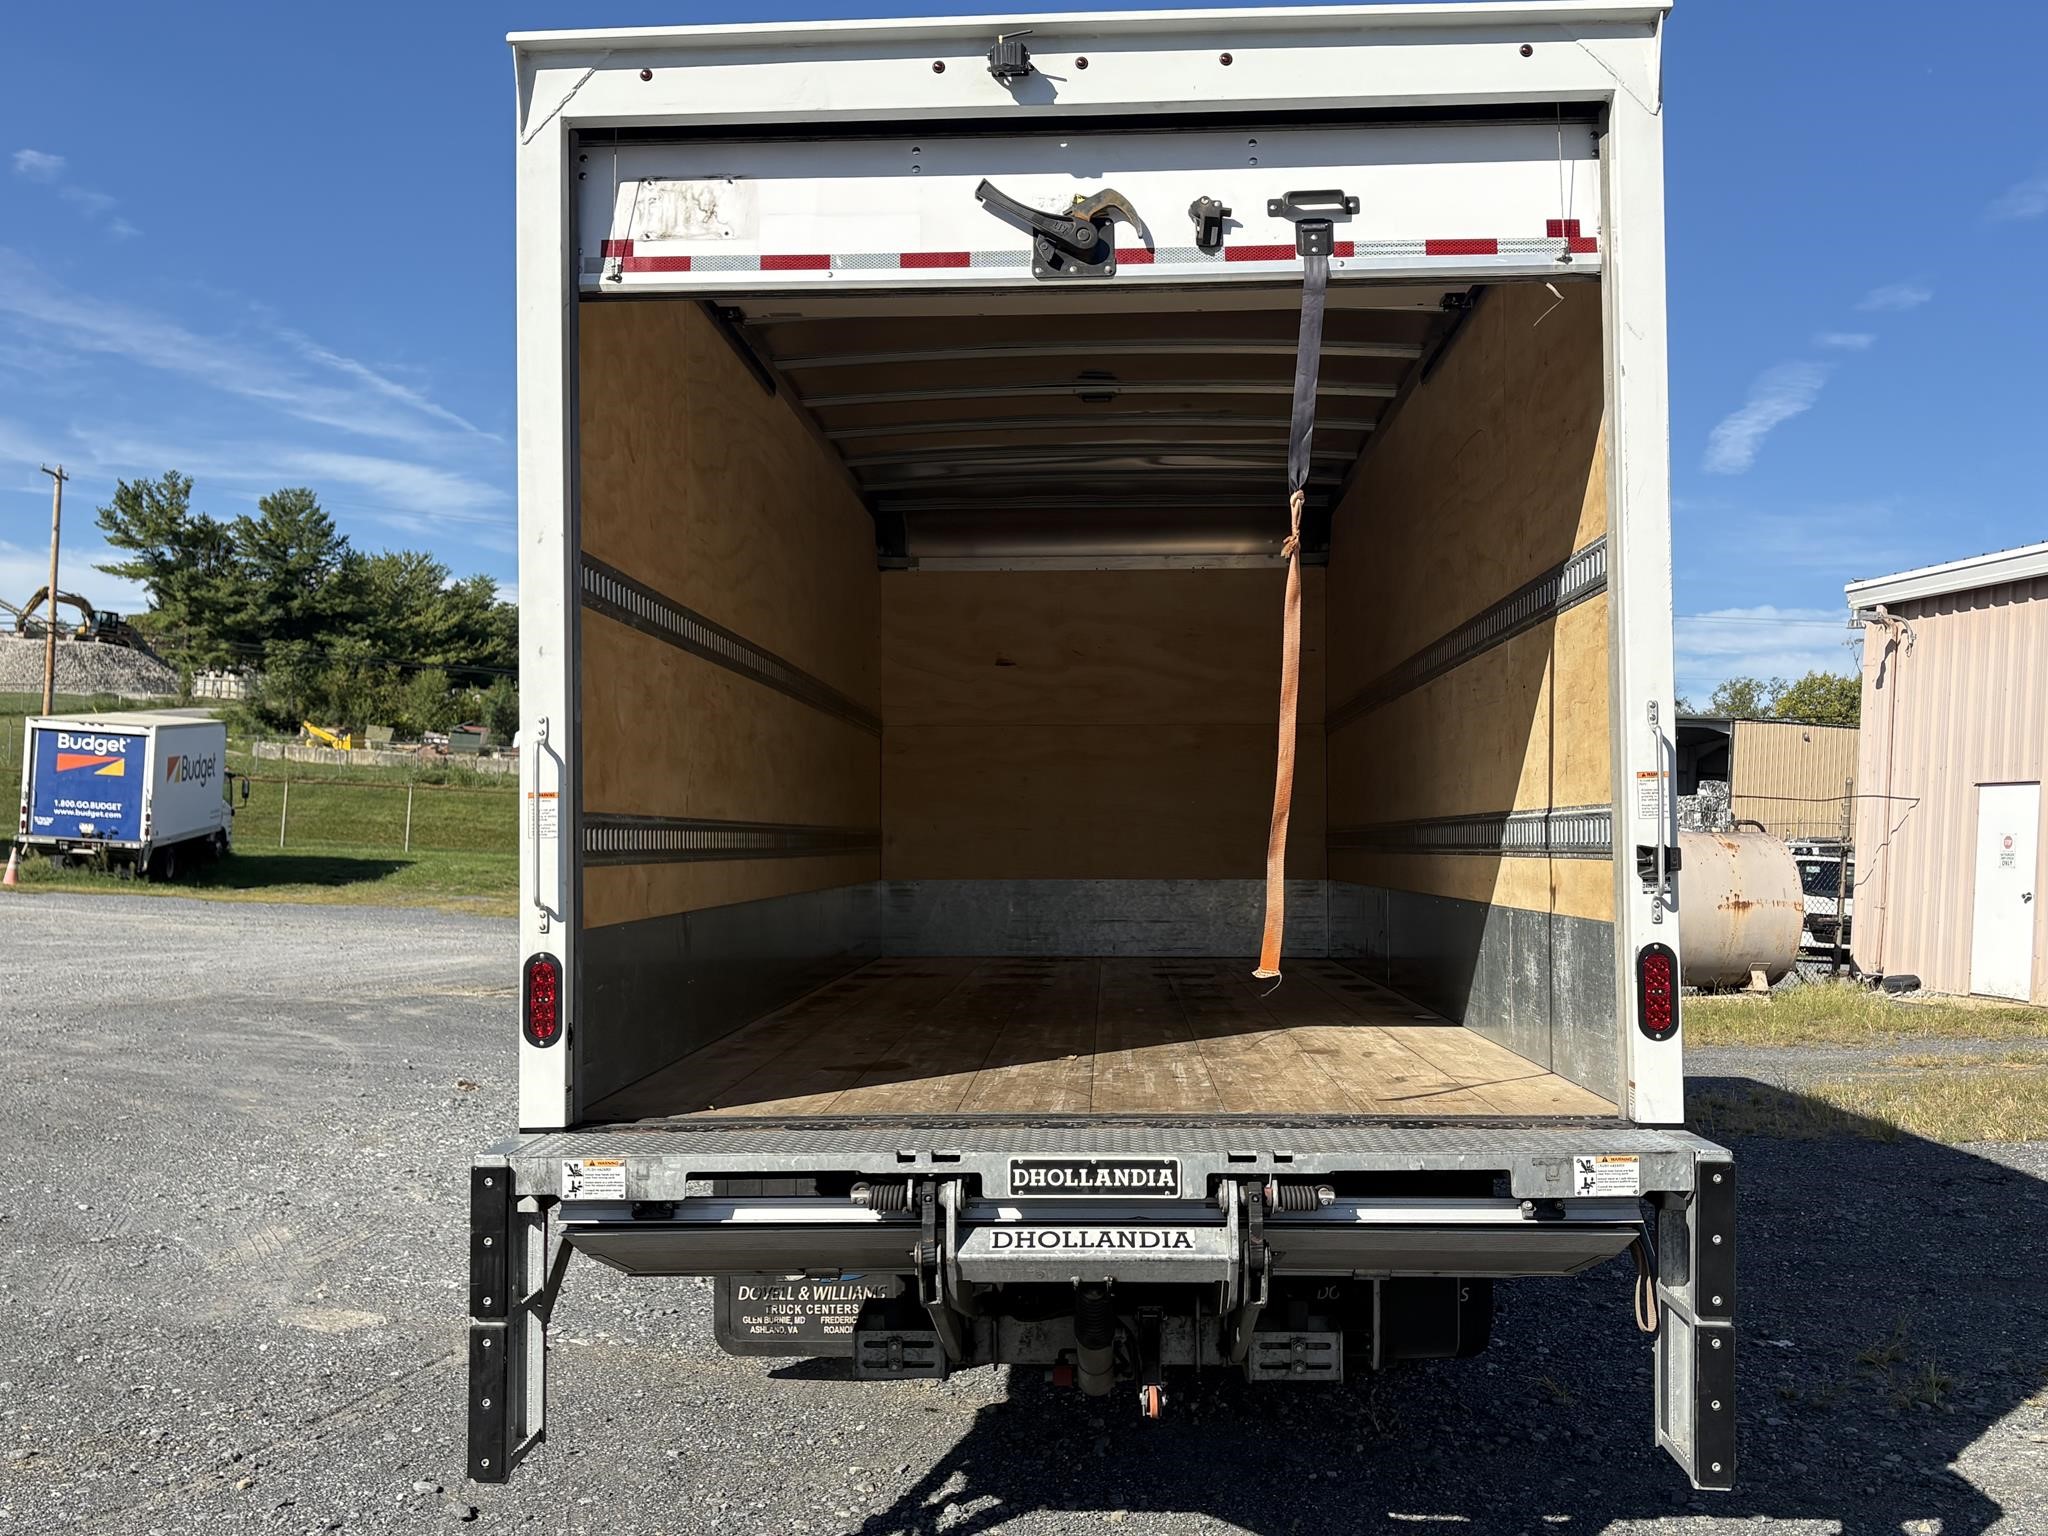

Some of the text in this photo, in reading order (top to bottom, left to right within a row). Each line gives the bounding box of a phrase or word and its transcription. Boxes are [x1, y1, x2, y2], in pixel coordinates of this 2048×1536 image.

[57, 732, 127, 756] Budget
[181, 752, 216, 788] Budget
[53, 808, 122, 819] www.budget.com
[1012, 1168, 1176, 1187] DHOLLANDIA
[991, 1230, 1193, 1249] DHOLLANDIA
[738, 1284, 888, 1301] DOVELL & WILLIAMS
[765, 1303, 860, 1315] TRUCK CENTERS
[742, 1316, 763, 1325] GLEN
[794, 1316, 806, 1325] MD
[820, 1316, 859, 1325] FREDERIC
[788, 1326, 799, 1335] VA
